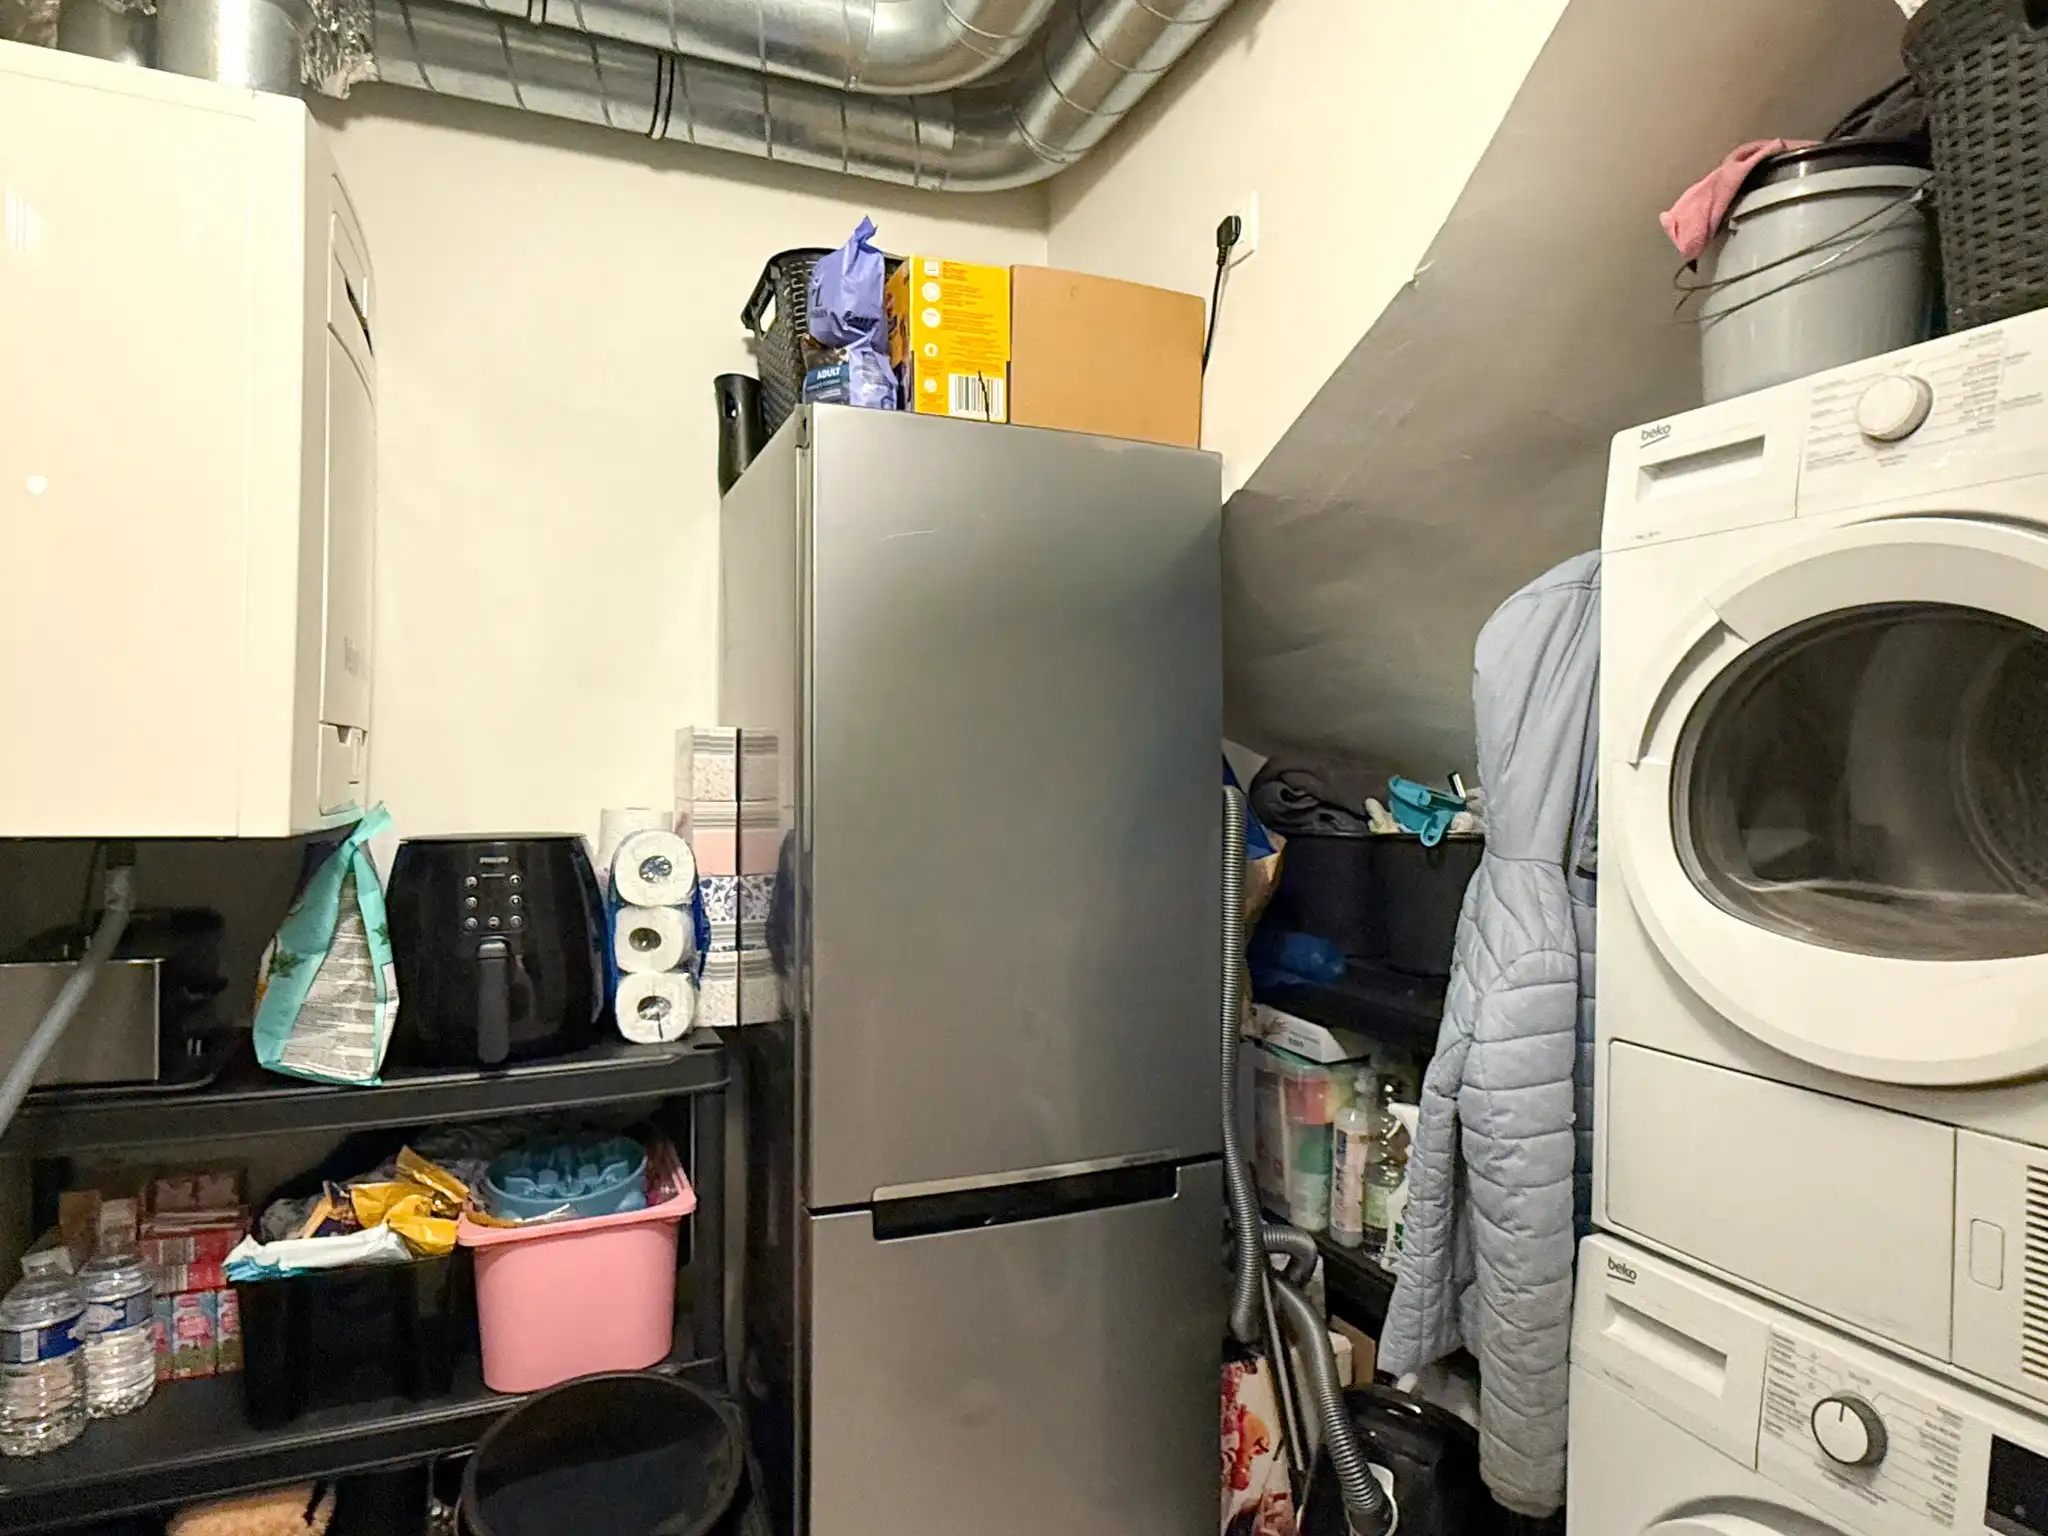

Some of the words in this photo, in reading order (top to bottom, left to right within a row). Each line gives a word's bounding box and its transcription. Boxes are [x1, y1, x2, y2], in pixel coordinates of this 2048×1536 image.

[816, 366, 841, 380] ADULT
[1641, 424, 1672, 441] beko
[1607, 1256, 1638, 1280] beko
